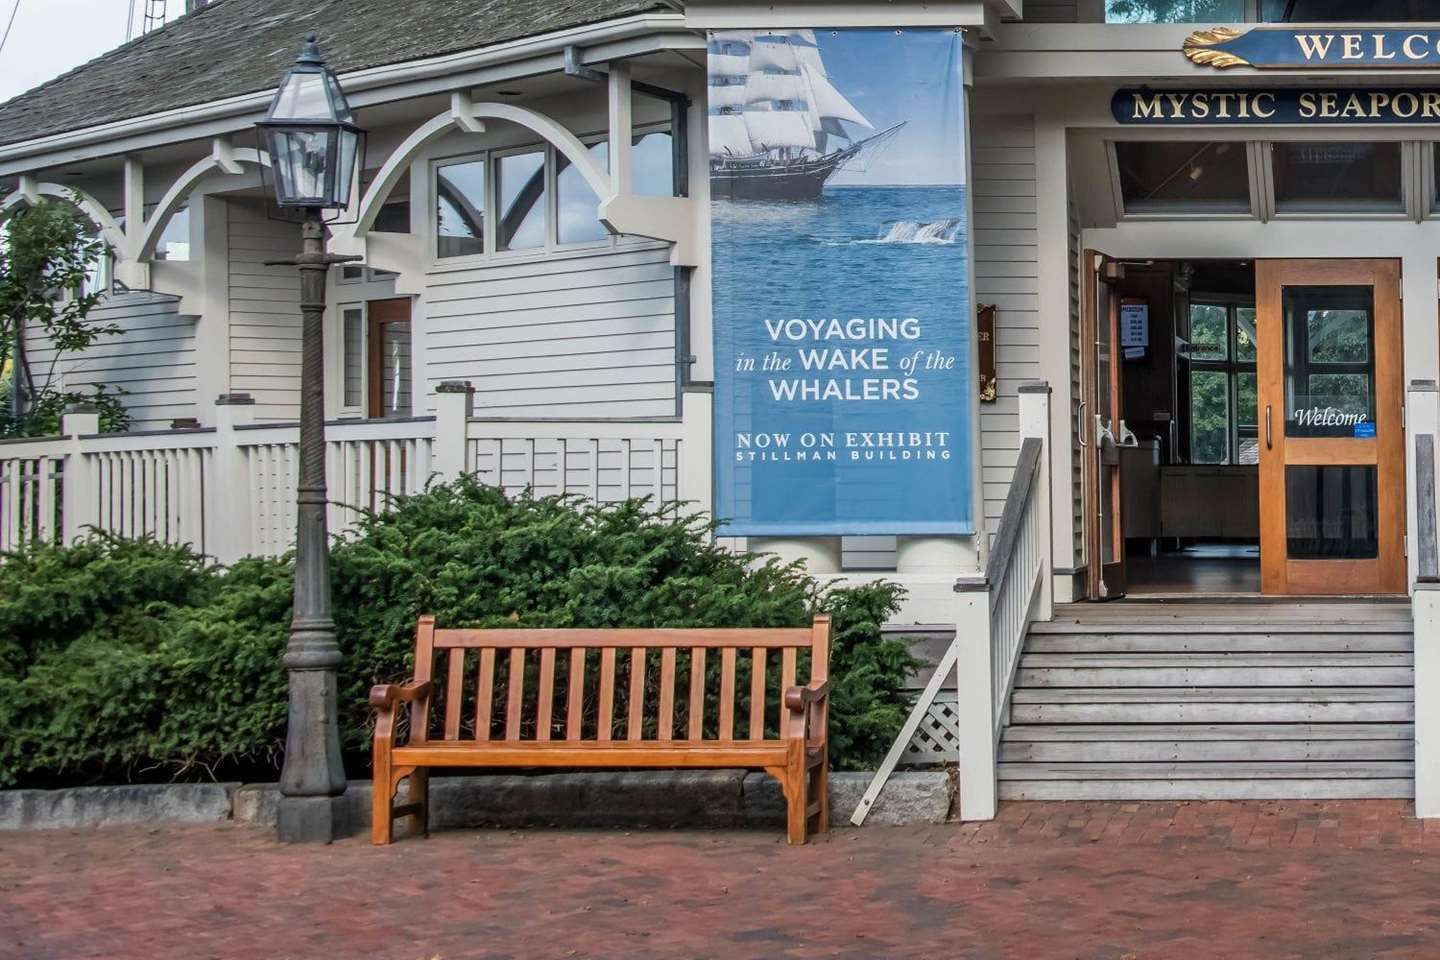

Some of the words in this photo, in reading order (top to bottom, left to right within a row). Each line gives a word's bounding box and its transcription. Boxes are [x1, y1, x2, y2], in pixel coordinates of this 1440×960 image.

[1132, 93, 1276, 120] MYSTIC
[764, 318, 921, 340] VOYAGING
[735, 353, 755, 372] in
[762, 352, 792, 371] the
[799, 348, 889, 370] WAKE
[899, 351, 923, 377] of
[925, 350, 955, 370] the
[768, 378, 920, 401] WHALERS
[1294, 406, 1367, 426] Welcome
[736, 433, 791, 448] NOW
[800, 432, 835, 448] ON
[845, 431, 950, 447] EXHIBIT
[735, 451, 837, 461] STILLMAN
[851, 450, 951, 460] BUILDING
